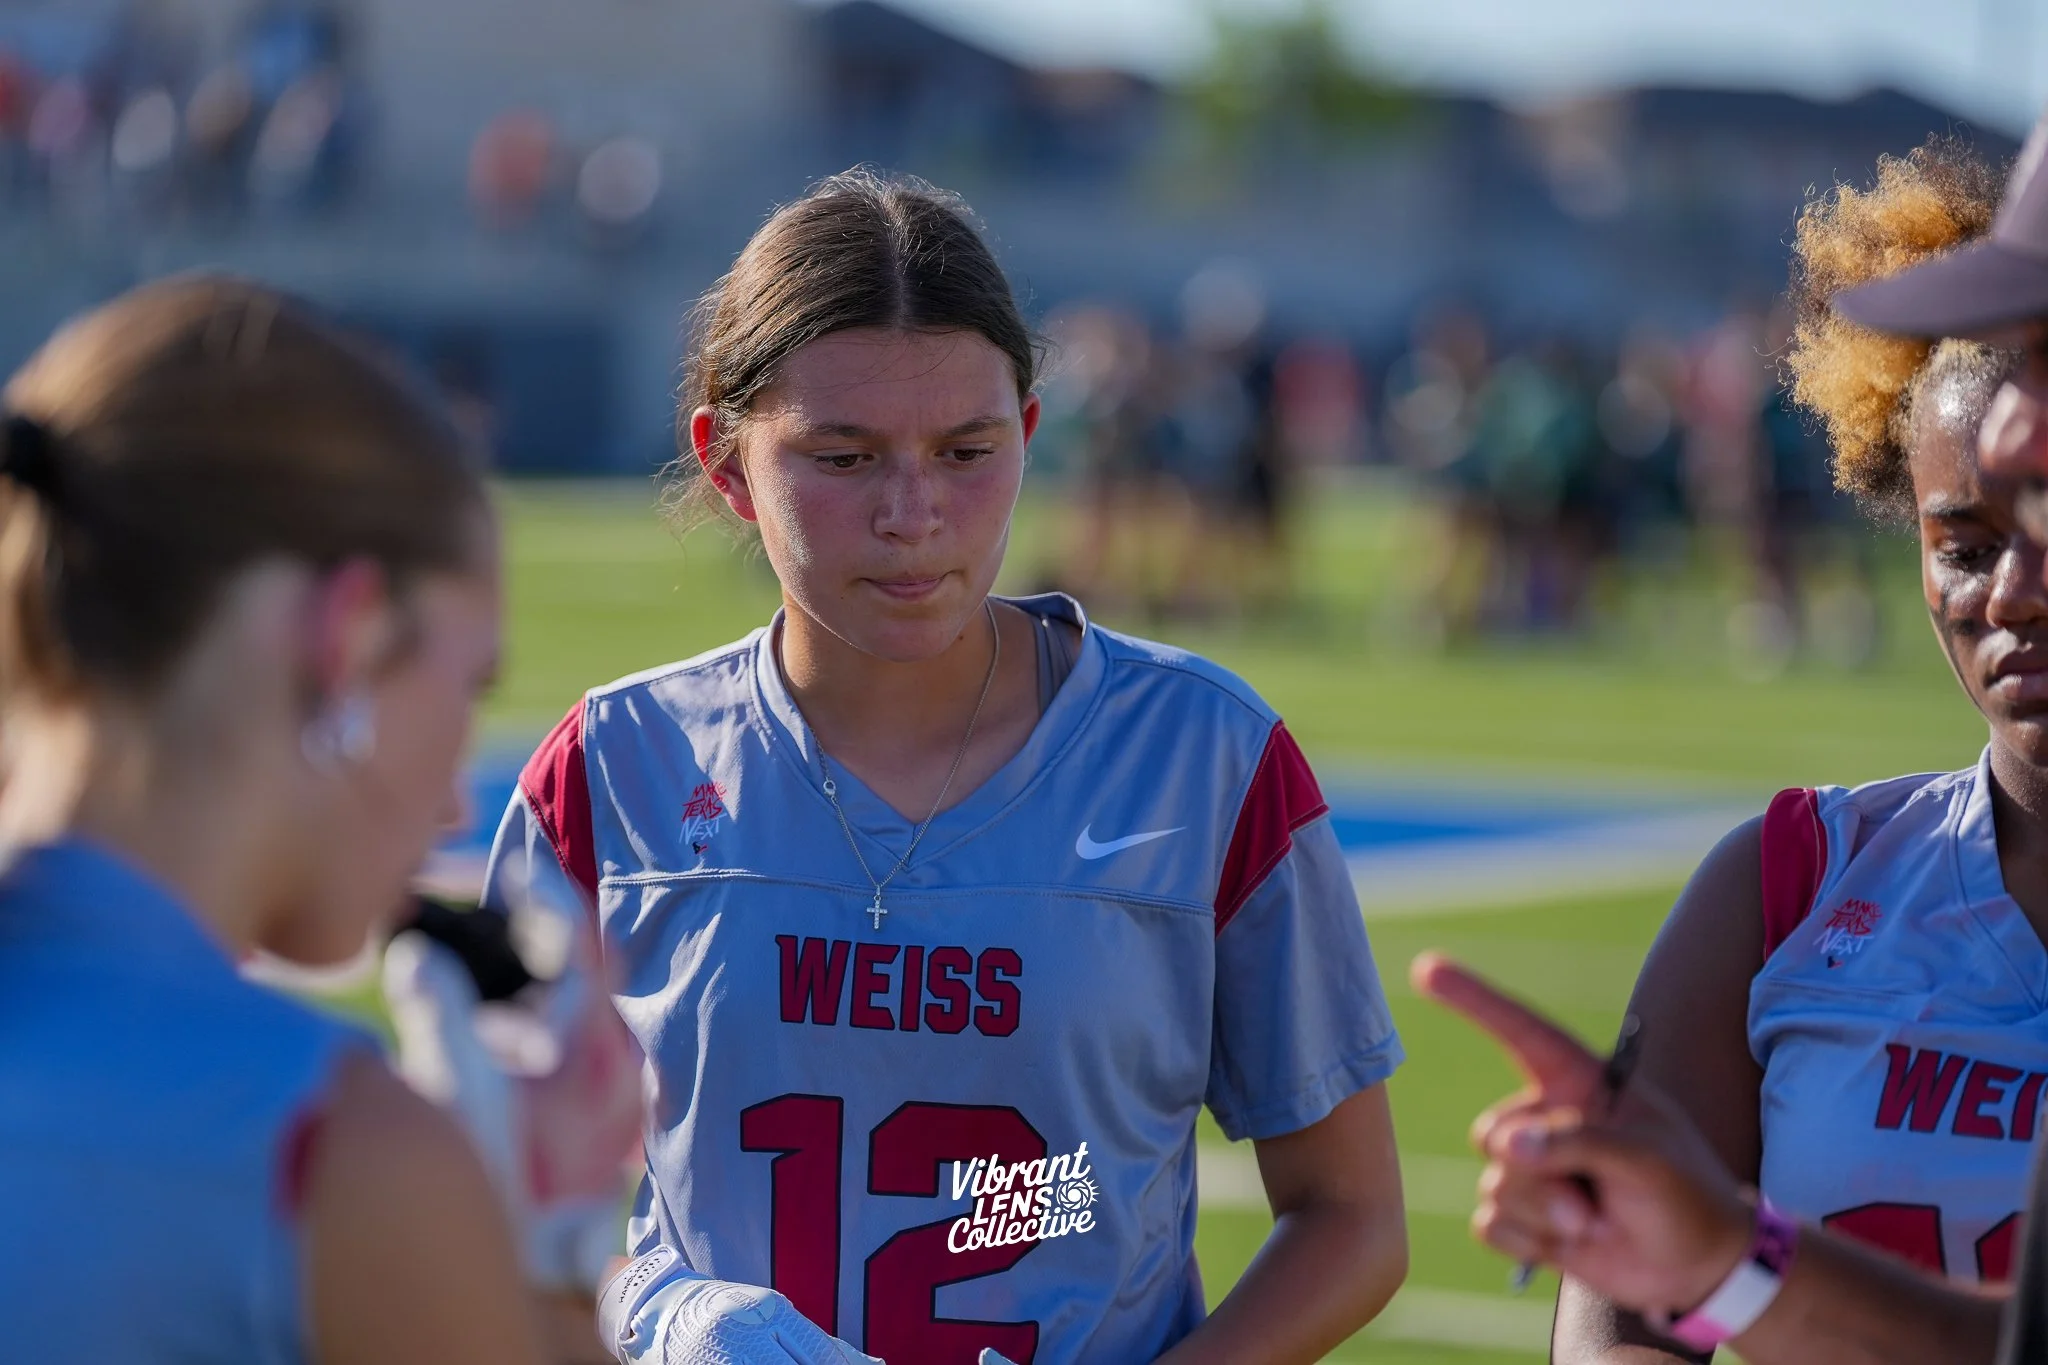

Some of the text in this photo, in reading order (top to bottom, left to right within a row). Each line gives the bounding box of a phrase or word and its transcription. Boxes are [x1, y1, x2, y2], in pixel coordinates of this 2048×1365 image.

[679, 812, 727, 844] NEXT
[682, 797, 722, 821] TEXAS
[1813, 926, 1875, 956] NEXT
[775, 934, 1022, 1037] WEISS
[1875, 1042, 2048, 1142] WEI
[740, 1092, 1048, 1365] 12
